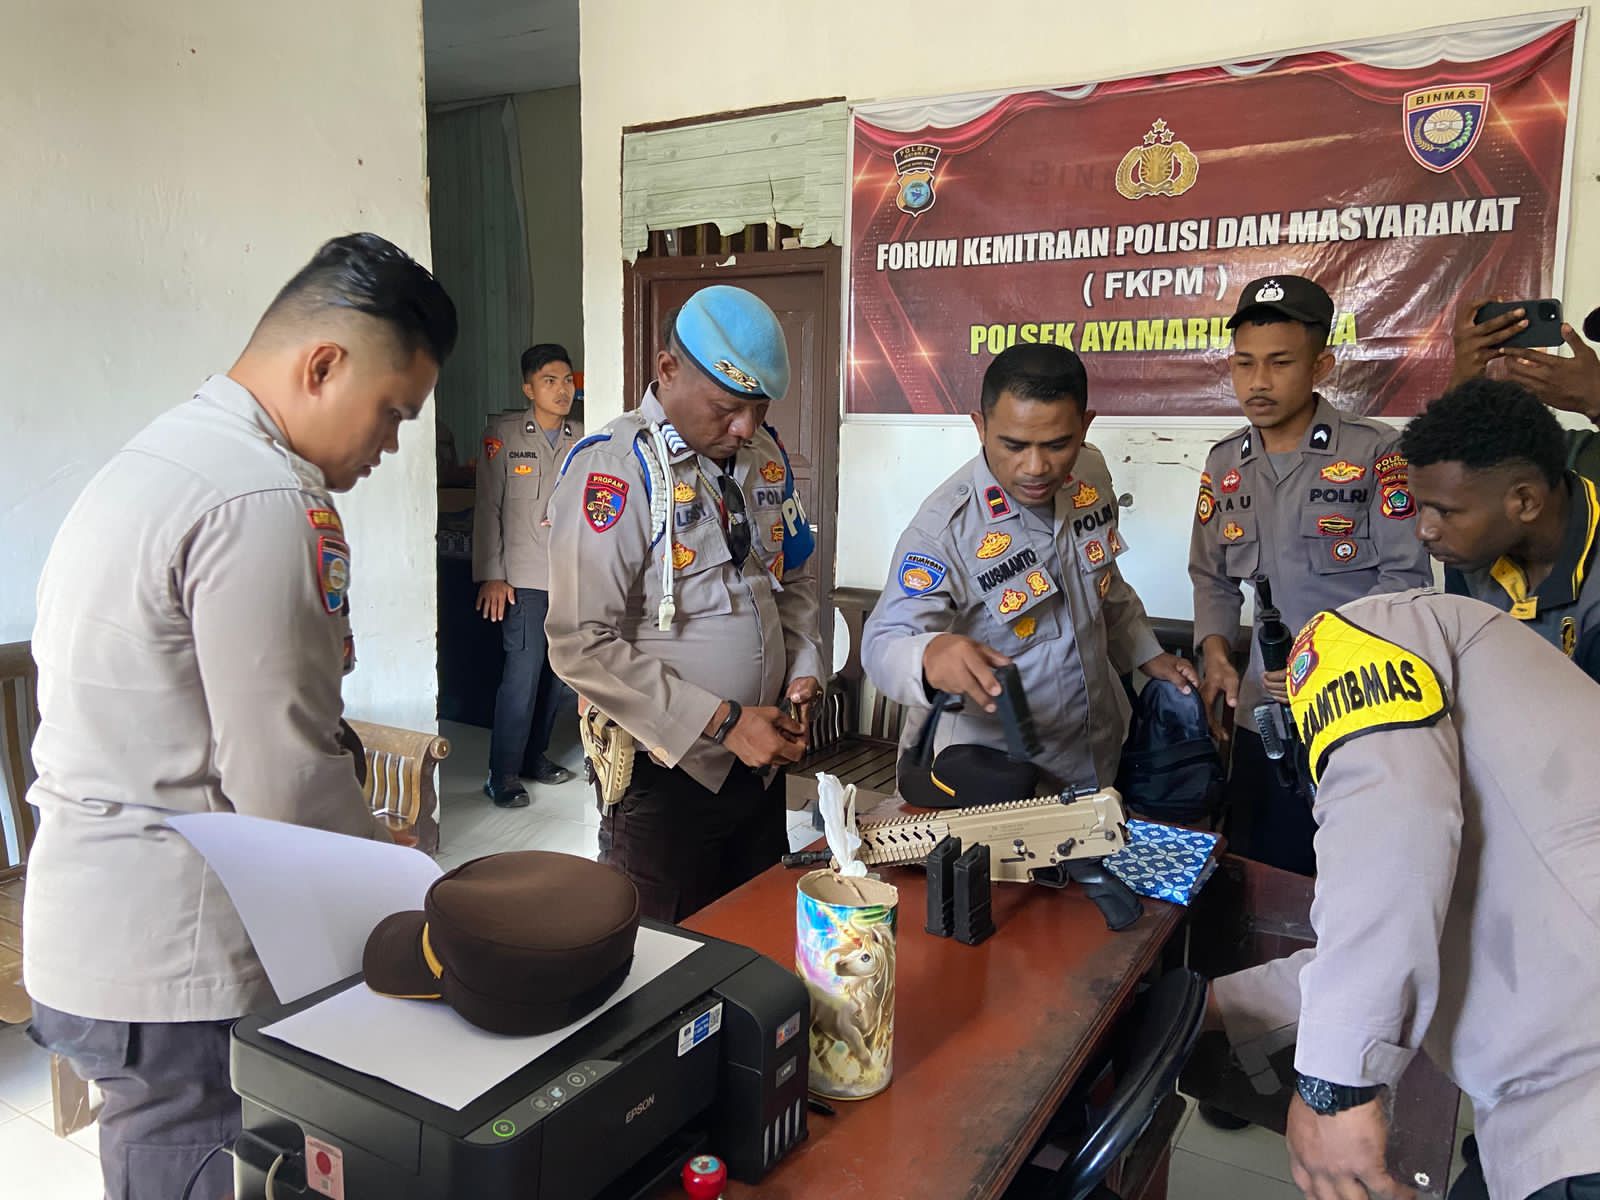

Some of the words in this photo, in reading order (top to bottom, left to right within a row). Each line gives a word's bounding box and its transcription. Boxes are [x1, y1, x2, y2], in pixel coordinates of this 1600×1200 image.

[1415, 90, 1477, 105] BINMAS
[900, 146, 934, 157] POLRES
[876, 239, 957, 271] FORUM
[962, 227, 1110, 266] KEMITRAAN
[1115, 219, 1210, 256] POLISI
[1216, 213, 1281, 249] DAN
[1288, 197, 1521, 244] MASYARAKAT
[1104, 266, 1205, 299] FKPM
[970, 322, 1075, 355] POLSEK
[1080, 316, 1232, 352] AYAMARU
[508, 451, 538, 459] CHAIRIL
[593, 475, 624, 488] PROPAM
[1310, 488, 1368, 503] POLRI
[977, 548, 1036, 592] KUSMANTO
[625, 1093, 655, 1124] EPSON
